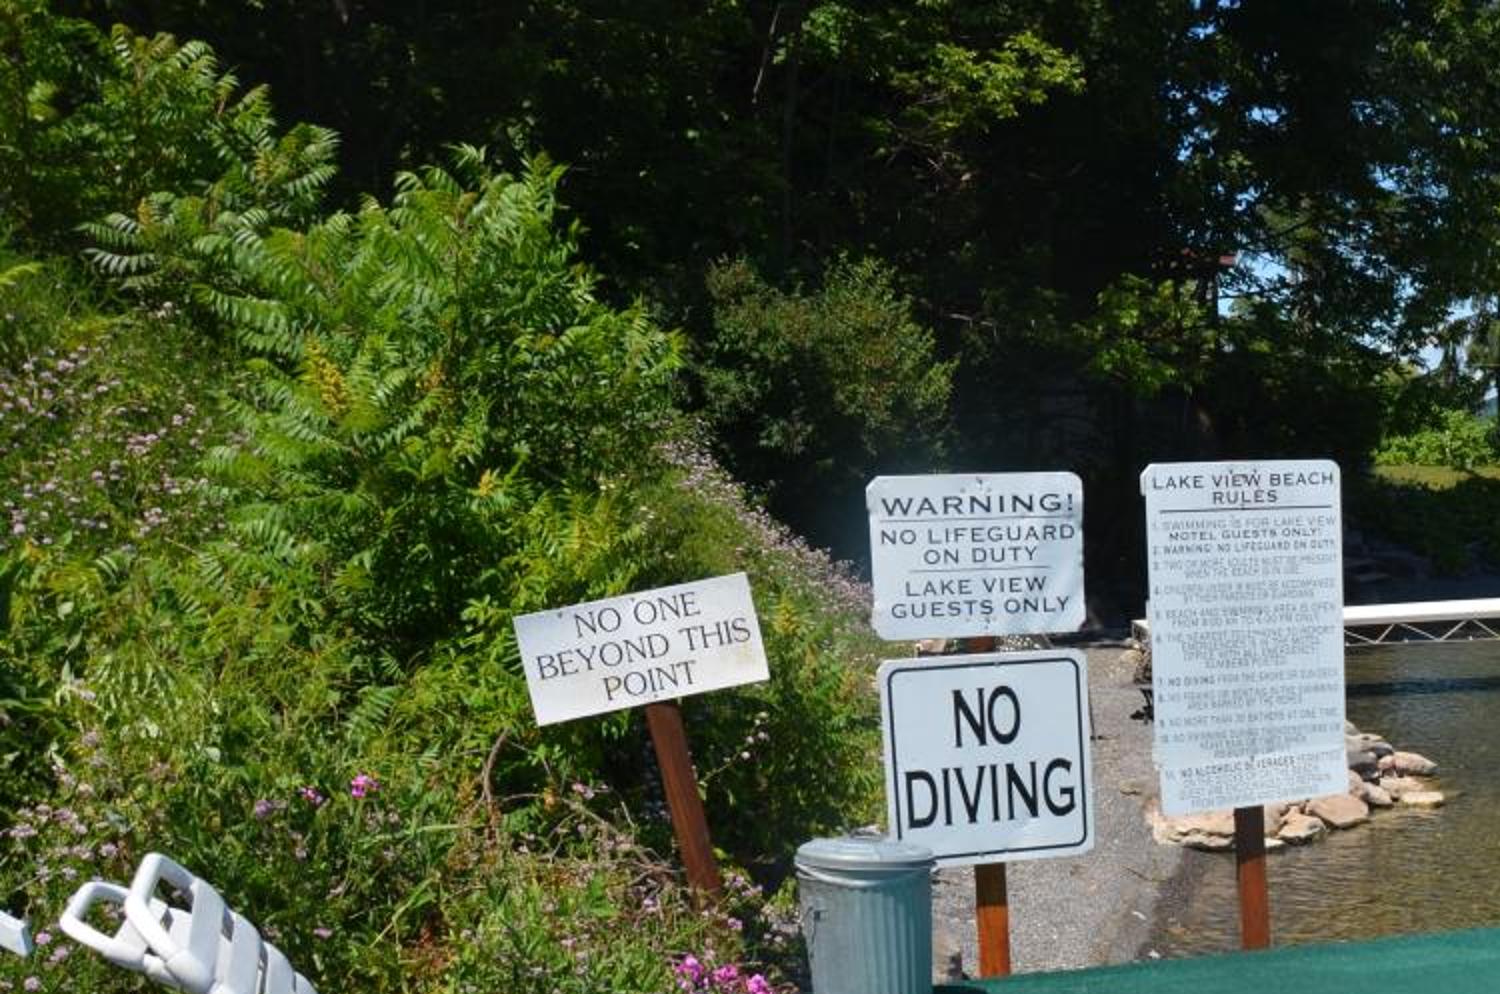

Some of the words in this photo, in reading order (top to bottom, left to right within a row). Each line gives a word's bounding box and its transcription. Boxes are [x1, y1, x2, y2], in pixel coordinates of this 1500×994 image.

[1152, 475, 1204, 490] LAKE
[1211, 473, 1262, 488] VIEW
[1269, 472, 1334, 487] BEACH
[881, 493, 1074, 517] WARNING!
[1212, 489, 1279, 505] RULES
[1274, 515, 1304, 528] LAKE
[1307, 515, 1337, 527] VIEW
[881, 529, 917, 546] NO
[928, 523, 1075, 545] LIFEGUARD
[1168, 530, 1217, 542] MOTEL
[1221, 528, 1278, 540] GUESTS
[1217, 542, 1231, 553] NO
[1234, 539, 1290, 553] LIFEGUARD
[1293, 538, 1307, 550] ON
[923, 548, 960, 565] ON
[972, 546, 1038, 563] DUTY
[905, 579, 973, 598] LAKE
[983, 576, 1048, 594] VIEW
[574, 607, 622, 638] NO
[633, 591, 703, 626] ONE
[891, 599, 994, 619] GUESTS
[1004, 596, 1070, 615] ONLY
[536, 632, 671, 681] BEYOND
[678, 617, 752, 651] THIS
[603, 659, 697, 701] POINT
[952, 684, 1022, 749] NO
[904, 757, 1077, 830] DIVING
